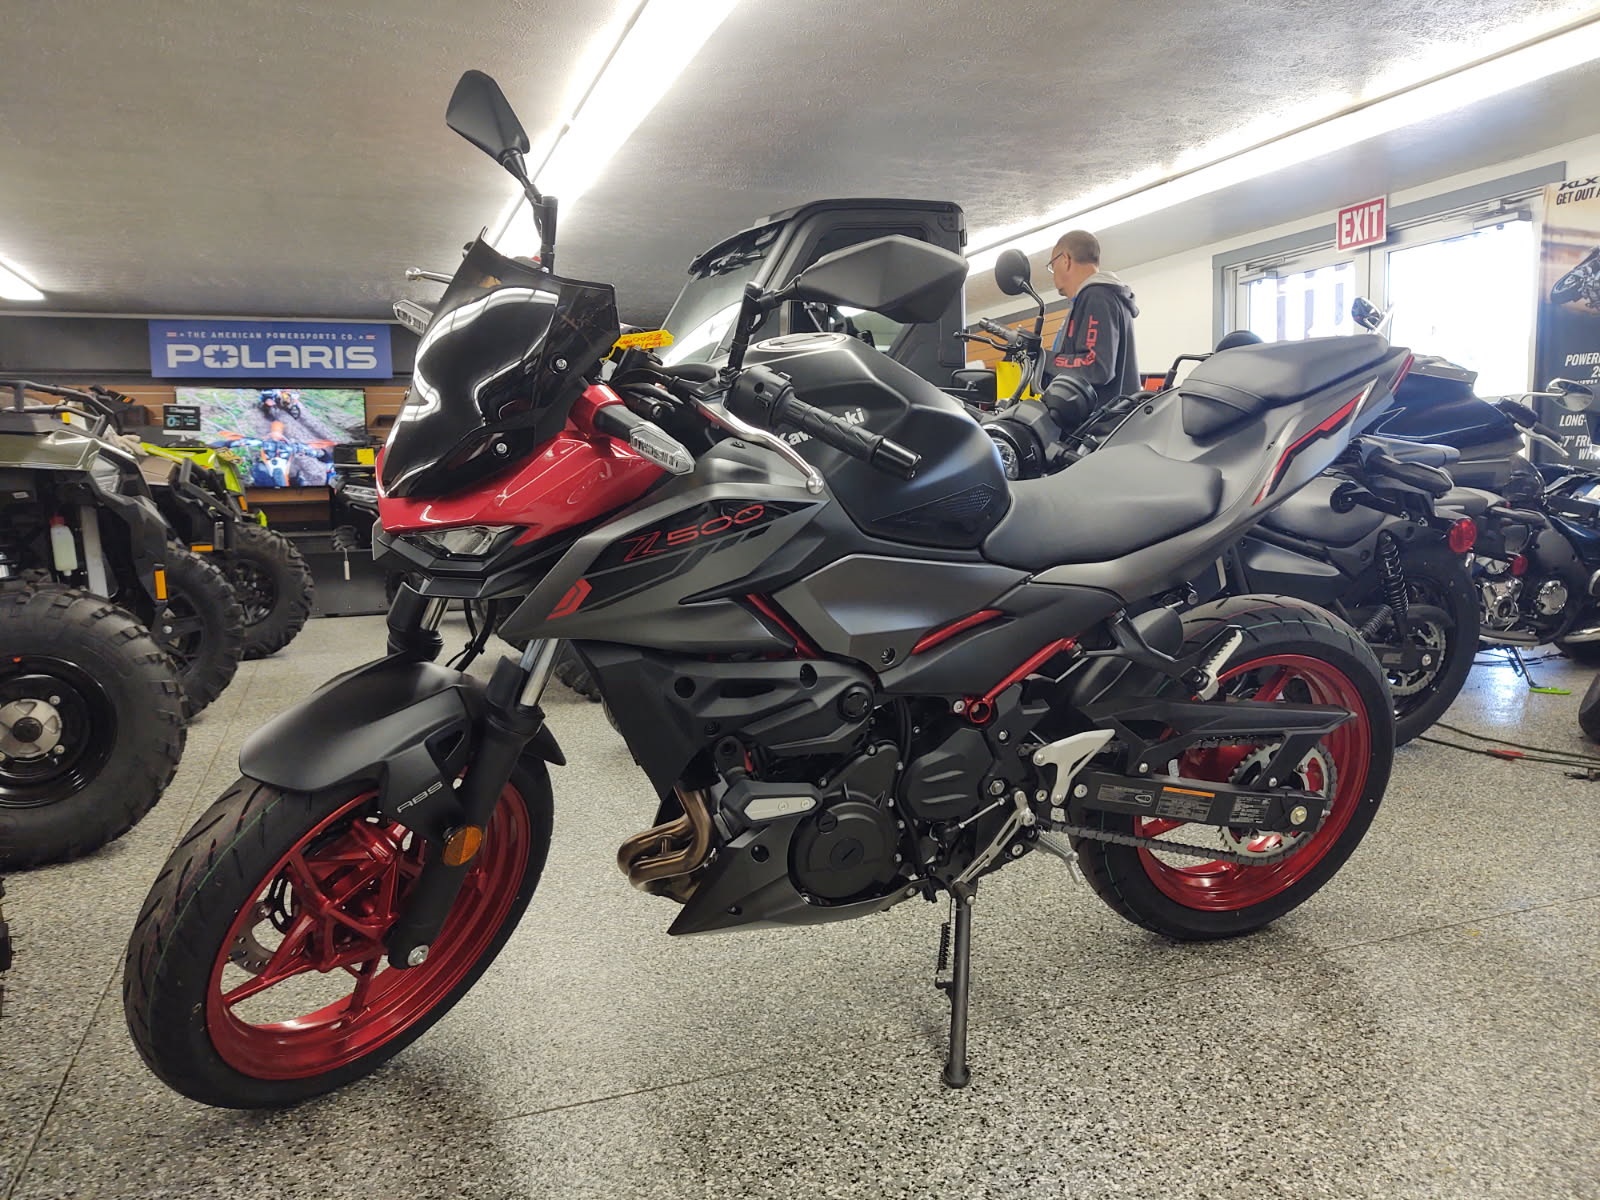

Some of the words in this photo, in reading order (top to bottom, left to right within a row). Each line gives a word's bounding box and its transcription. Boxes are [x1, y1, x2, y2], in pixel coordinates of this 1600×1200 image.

[1558, 176, 1600, 191] KLX
[1556, 191, 1574, 205] GET
[1574, 187, 1596, 202] OUT
[1341, 203, 1381, 246] EXIT
[187, 330, 206, 339] THE
[211, 331, 262, 340] AMERICAN
[266, 332, 336, 341] POWERSPORTS
[340, 333, 357, 341] CO.
[166, 343, 378, 370] POLARIS
[1564, 352, 1600, 367] POWER
[397, 781, 443, 813] ABS
